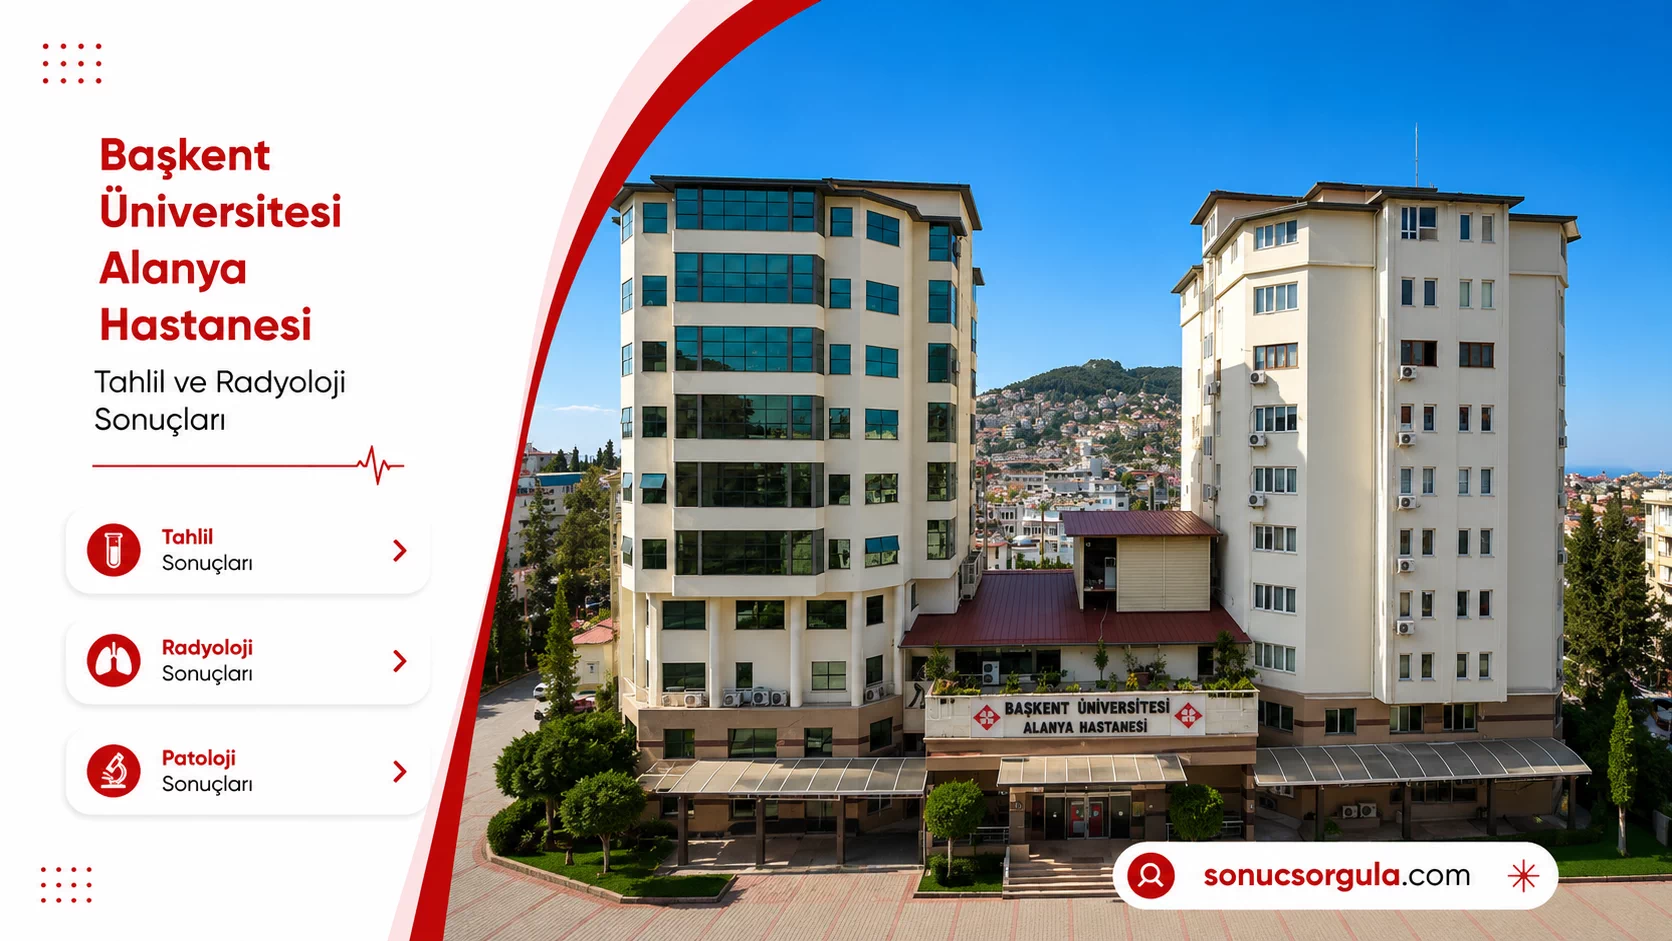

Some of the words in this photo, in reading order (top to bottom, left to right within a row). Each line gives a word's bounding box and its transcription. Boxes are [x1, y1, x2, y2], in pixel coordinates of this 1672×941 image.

[1005, 701, 1070, 718] BAŞKENT
[1023, 720, 1074, 734] ALANYA
[1079, 717, 1148, 734] HASTANESİ
